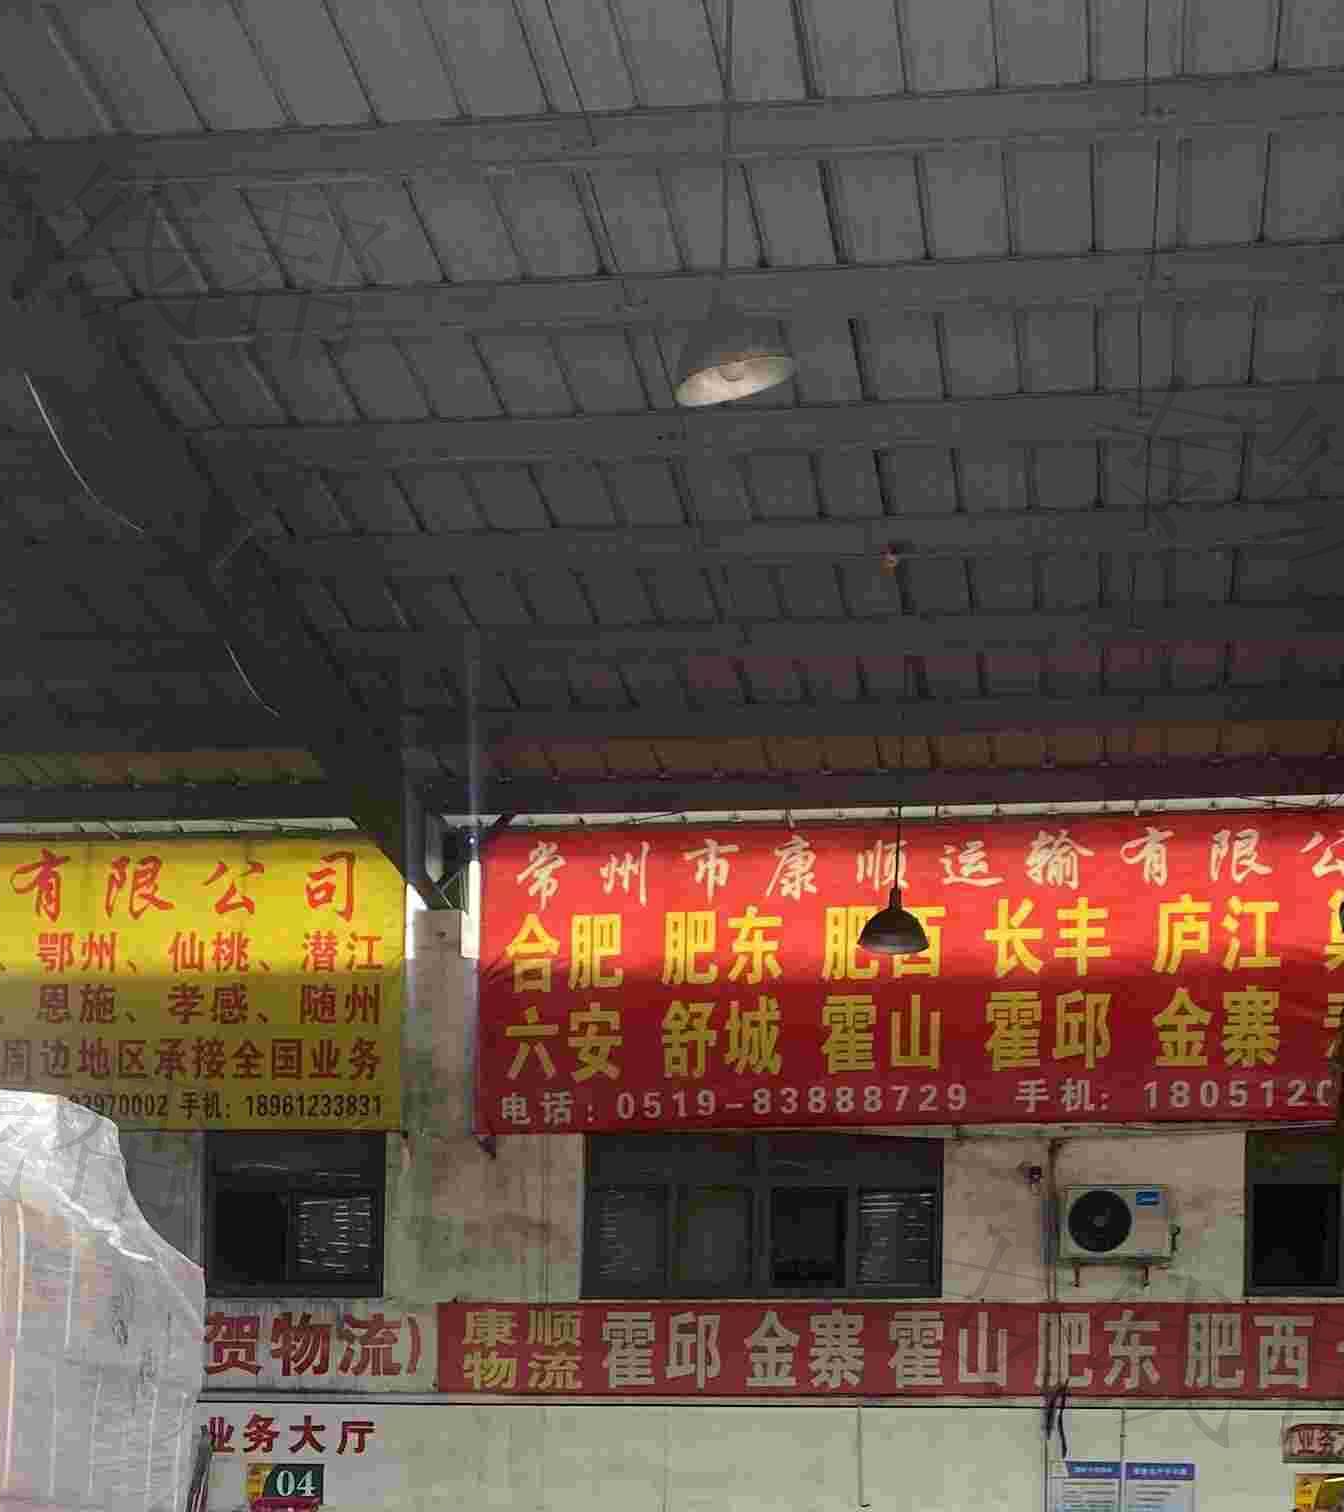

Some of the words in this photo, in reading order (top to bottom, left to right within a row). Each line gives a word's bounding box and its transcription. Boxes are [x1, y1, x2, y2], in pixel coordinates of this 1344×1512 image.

[505, 912, 624, 993] 合肥
[661, 905, 783, 985] 肥东
[984, 896, 1112, 977] 长丰
[1153, 892, 1281, 975] 庐江
[504, 1002, 624, 1082] 六安
[661, 1000, 783, 1080] 舒城
[822, 994, 943, 1074] 霍山
[984, 990, 1112, 1072] 霍邱
[1153, 985, 1281, 1068] 金寨
[462, 1310, 583, 1347] 康顺
[601, 1311, 721, 1391] 霍邱
[744, 1308, 864, 1388] 金寨
[888, 1310, 1008, 1389] 霍山
[1035, 1310, 1160, 1389] 肥东
[1185, 1312, 1314, 1389] 肥西
[463, 1350, 583, 1390] 物流
[201, 1411, 376, 1455] 业务大厅
[275, 1470, 315, 1497] 04
